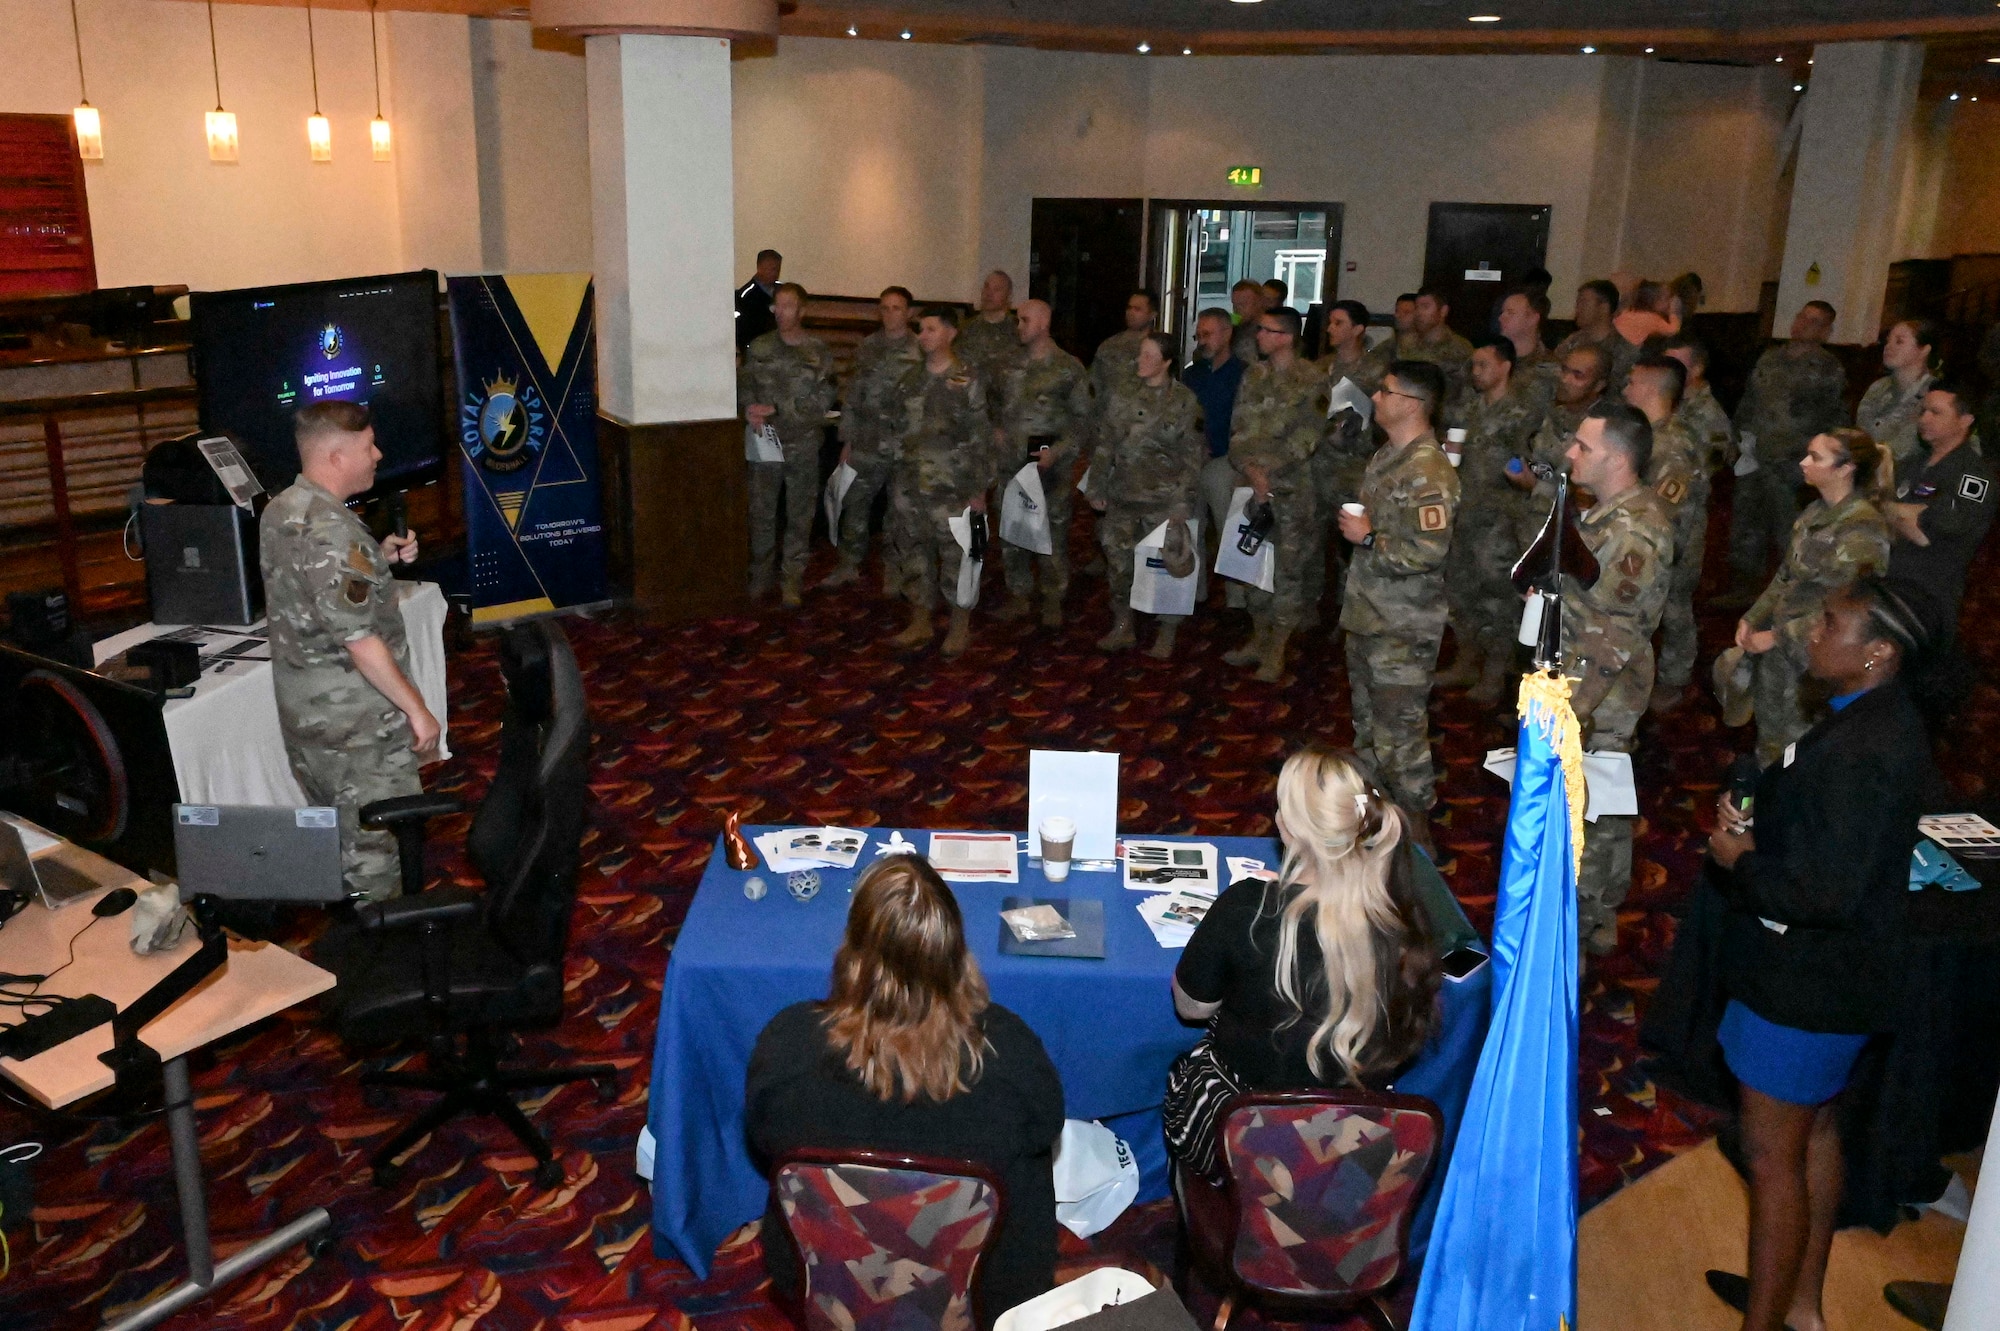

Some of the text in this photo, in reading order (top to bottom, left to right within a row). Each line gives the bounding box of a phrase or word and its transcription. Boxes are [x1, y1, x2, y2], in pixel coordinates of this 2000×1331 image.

[304, 366, 362, 387] Igniting Innovation
[313, 381, 356, 397] for Tomorrow
[462, 385, 545, 458] ROYAL SPARK
[1962, 477, 1984, 498] D
[535, 518, 586, 531] TOMORROW'S
[519, 525, 601, 542] SOLUTIONS DELIVERED
[549, 538, 574, 547] TODAY
